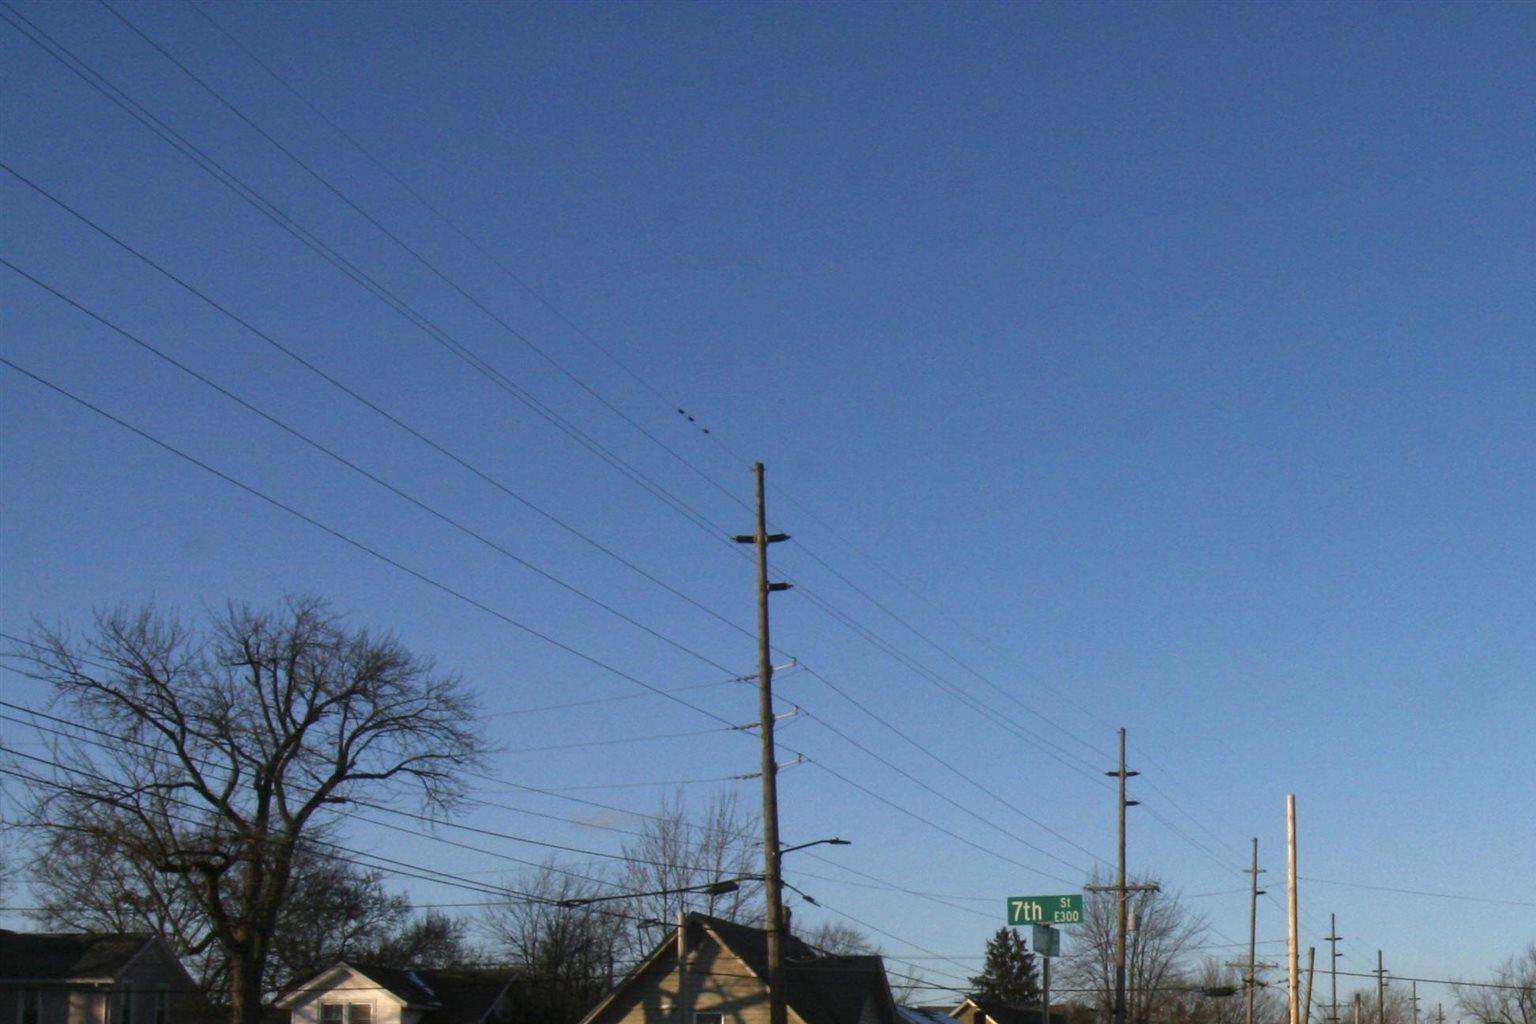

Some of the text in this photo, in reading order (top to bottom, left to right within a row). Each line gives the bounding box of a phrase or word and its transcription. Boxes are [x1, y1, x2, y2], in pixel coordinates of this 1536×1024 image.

[1011, 897, 1071, 921] 7th St
[1054, 910, 1079, 922] E300
